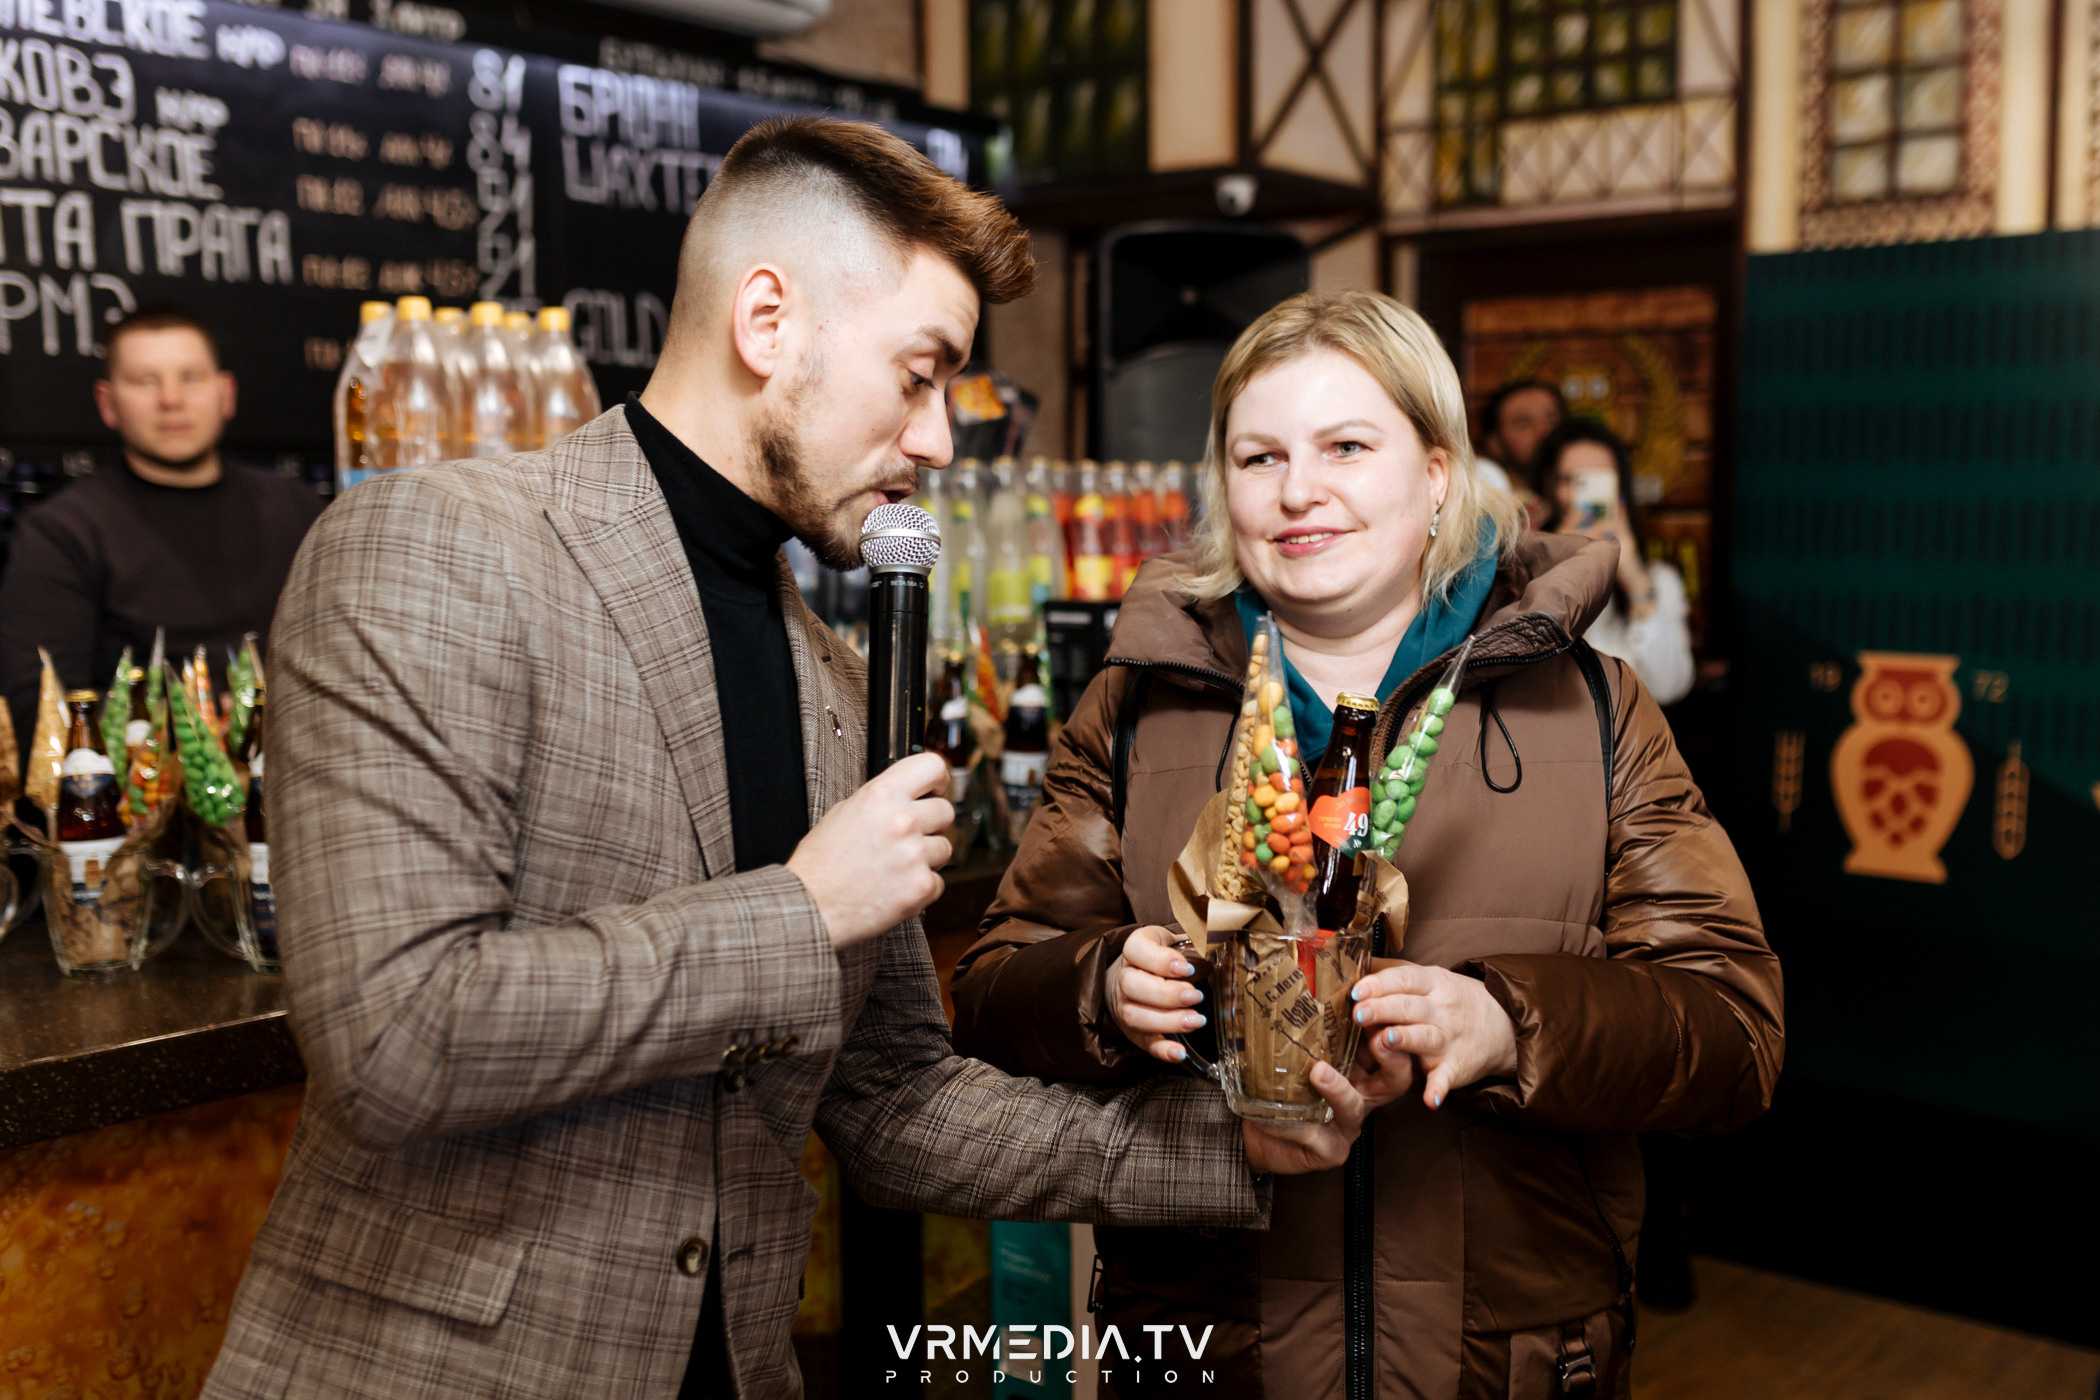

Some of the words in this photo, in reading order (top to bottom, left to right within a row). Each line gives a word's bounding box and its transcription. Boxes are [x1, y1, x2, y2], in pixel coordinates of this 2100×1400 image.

[0, 187, 98, 271] ТА
[120, 198, 294, 286] ПРАГА
[1343, 811, 1369, 837] 49
